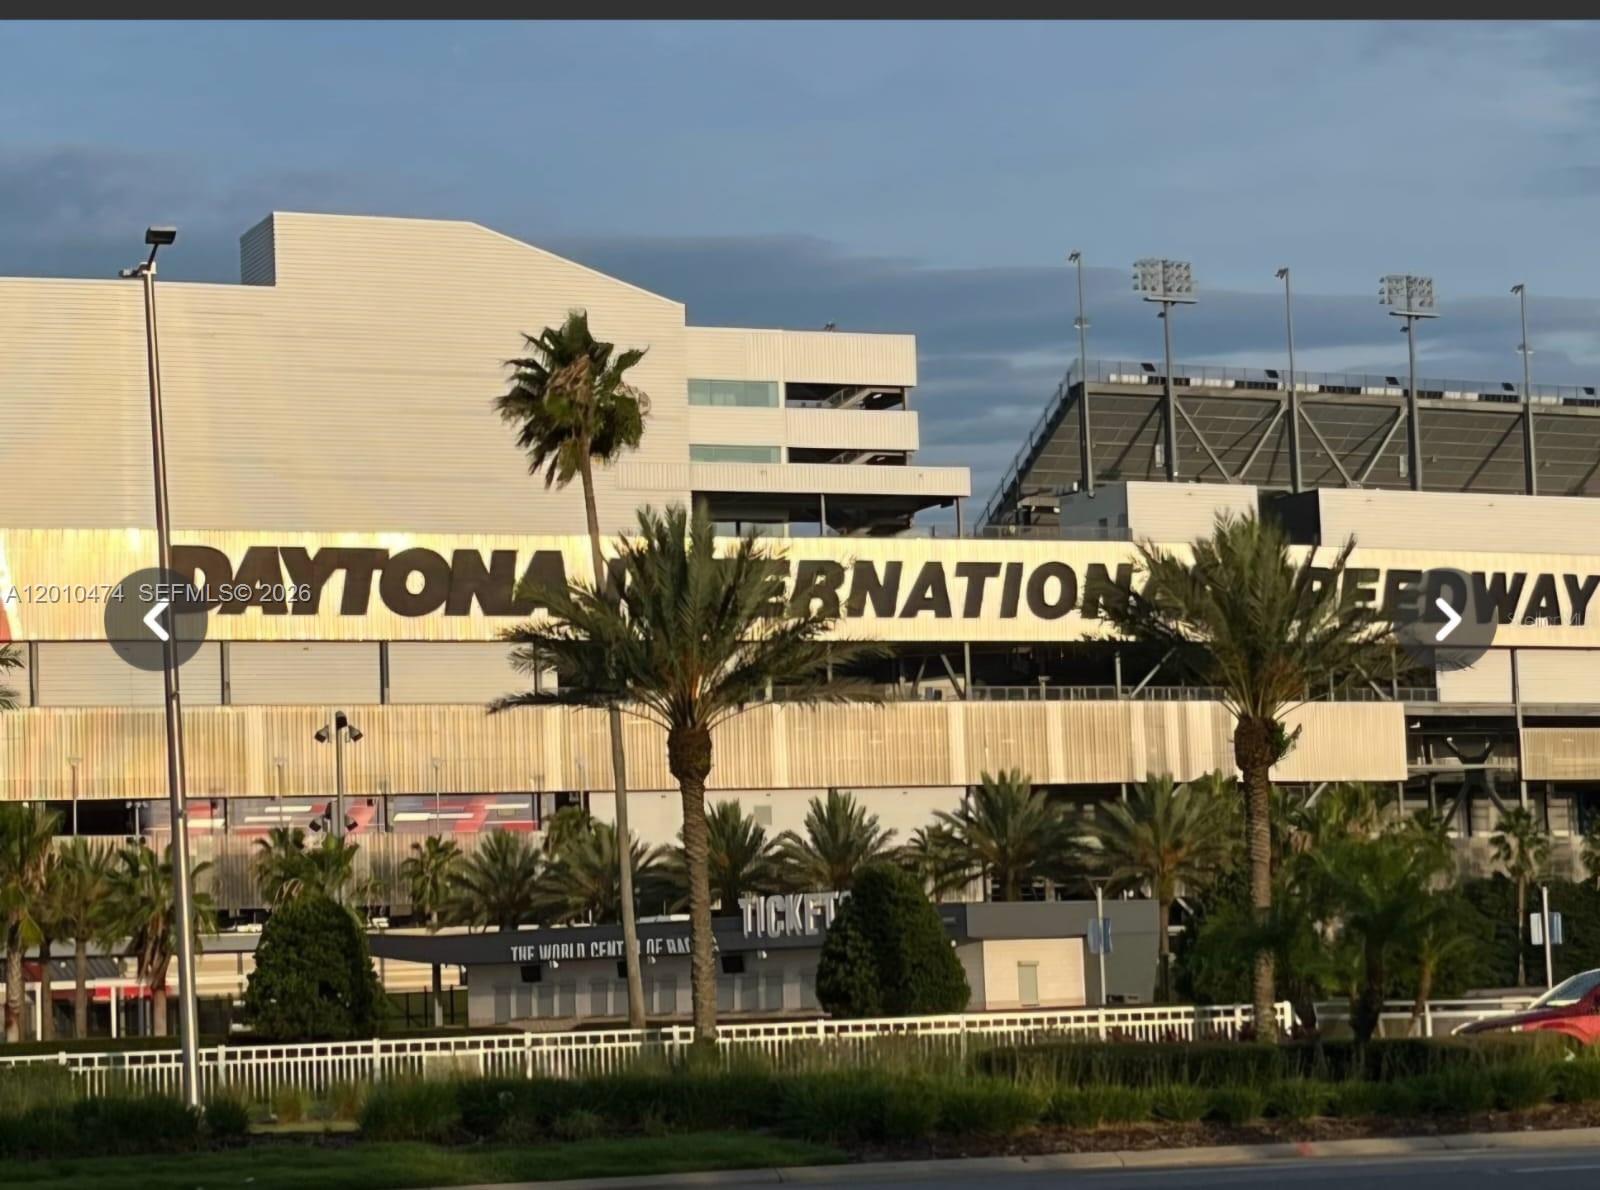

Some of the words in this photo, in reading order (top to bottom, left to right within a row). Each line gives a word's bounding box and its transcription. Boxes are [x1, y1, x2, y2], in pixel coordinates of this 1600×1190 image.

[171, 545, 573, 618] DAYTONA
[738, 890, 852, 938] TICKET
[510, 944, 535, 962] THE
[539, 942, 586, 960] WORLD
[646, 938, 663, 954] OF
